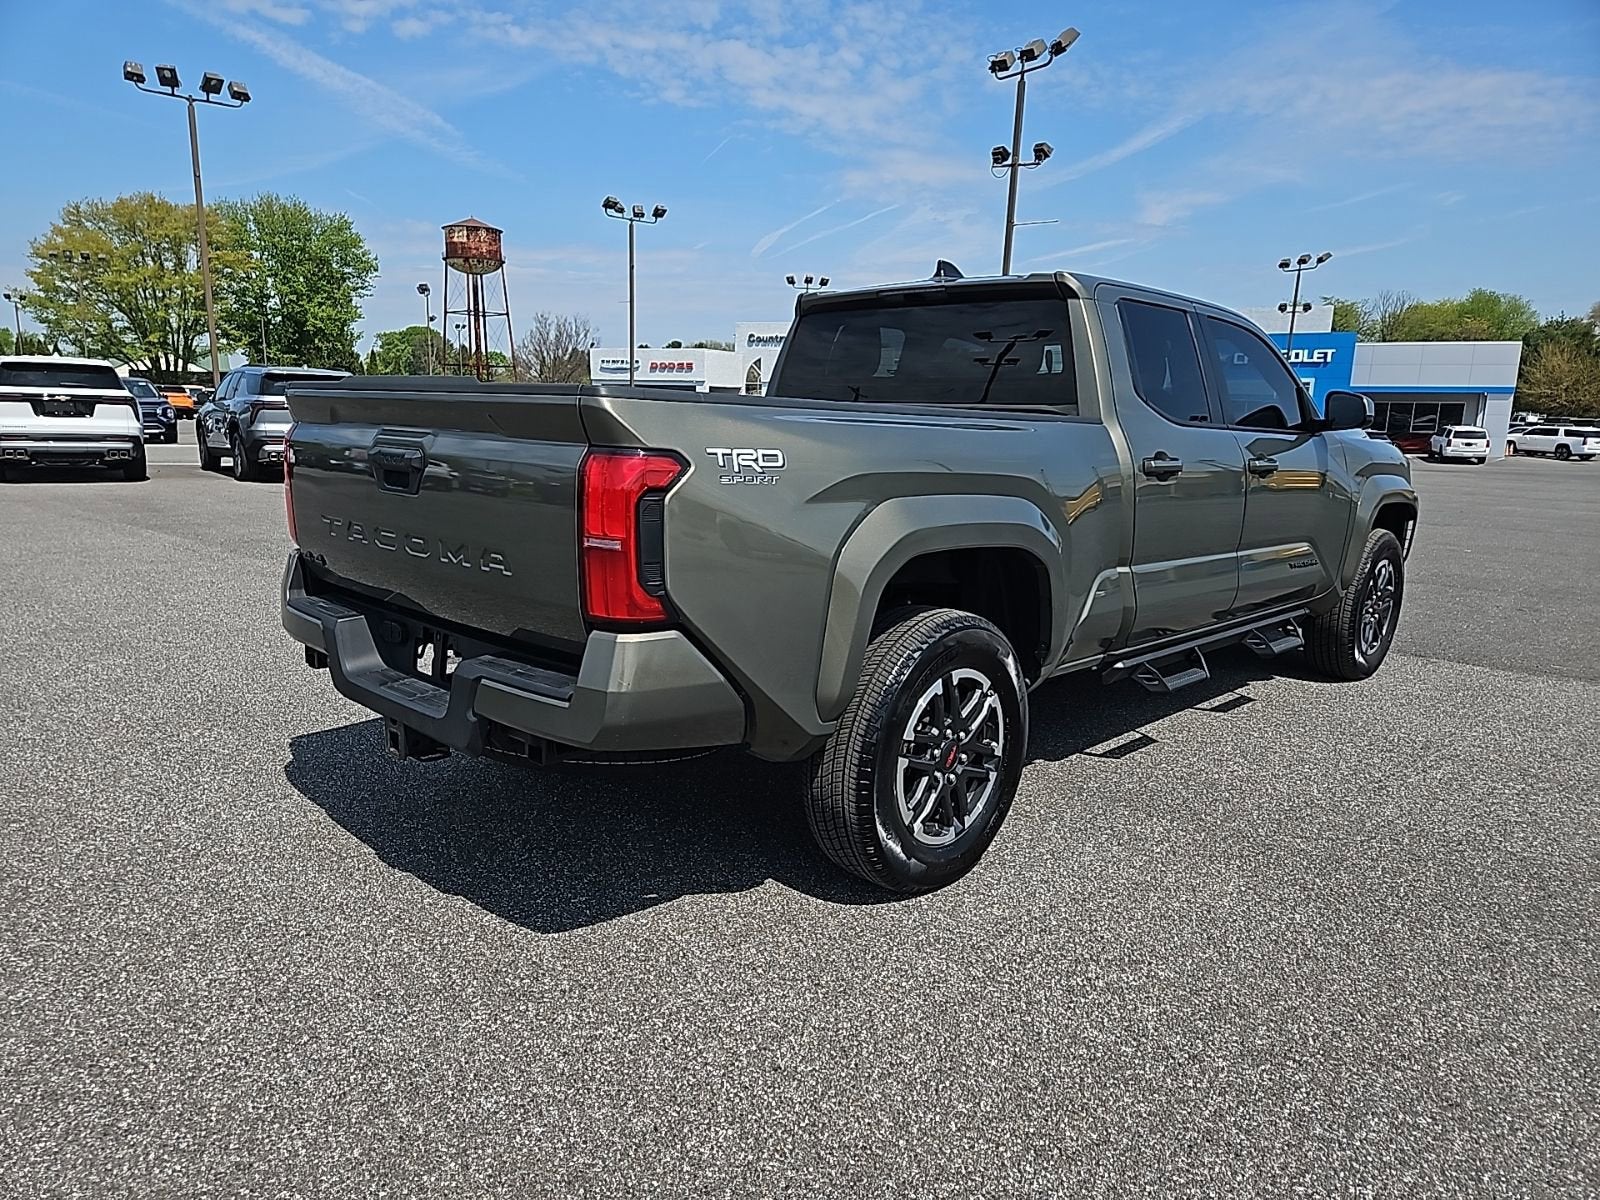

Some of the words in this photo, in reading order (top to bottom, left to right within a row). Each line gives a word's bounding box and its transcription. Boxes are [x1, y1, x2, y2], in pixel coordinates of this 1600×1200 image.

[748, 333, 786, 344] Countr
[705, 447, 785, 473] TRD
[719, 475, 780, 485] SPORT
[320, 513, 513, 577] TACOMA
